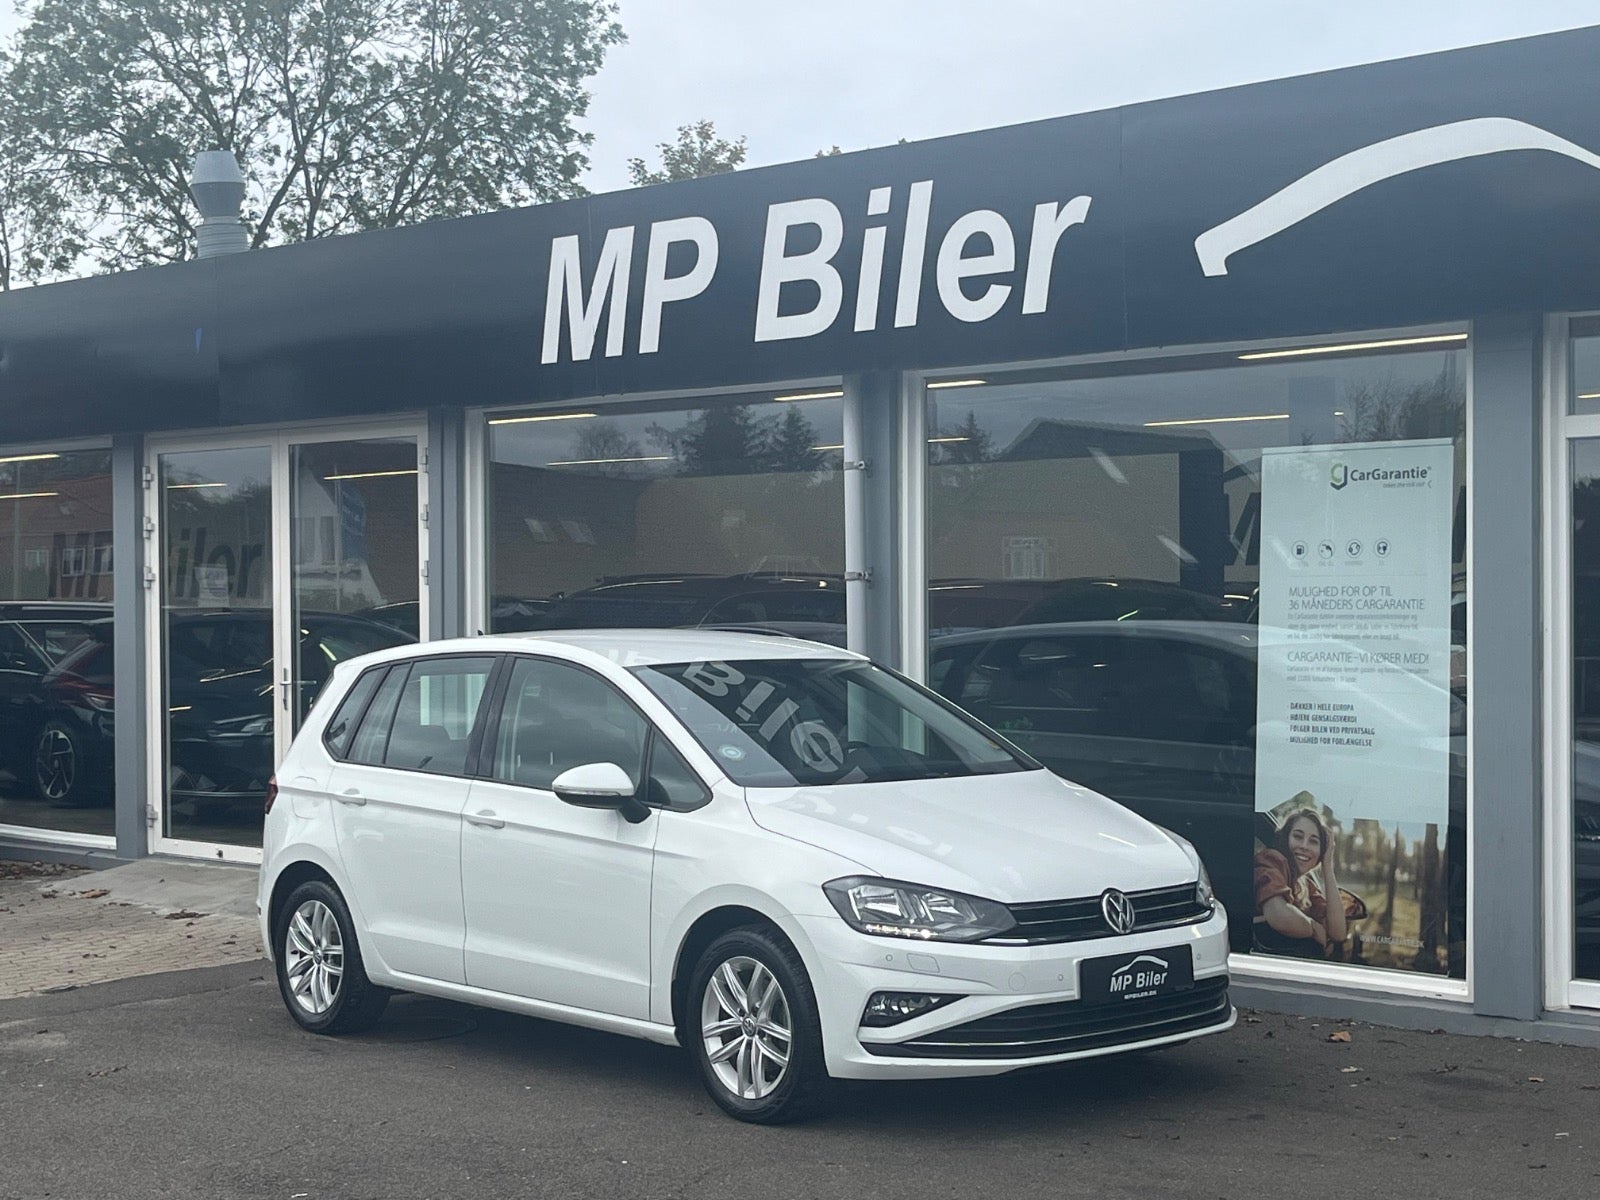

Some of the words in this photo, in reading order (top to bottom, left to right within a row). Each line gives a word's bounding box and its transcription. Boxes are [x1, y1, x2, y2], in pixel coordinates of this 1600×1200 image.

[541, 216, 719, 364] MP
[754, 179, 1092, 342] Biler
[1350, 466, 1428, 481] CarGarantie
[1288, 586, 1339, 598] MULIGHED
[1341, 586, 1361, 598] FOR
[1362, 586, 1377, 598] OP
[1380, 586, 1393, 597] TIL
[1288, 600, 1299, 610] 36
[1301, 598, 1354, 611] MÅNEDERS
[1356, 599, 1425, 610] CARGARANTIE
[1287, 652, 1352, 664] CARGARANTIE
[1332, 703, 1354, 711] EUROPA
[1341, 727, 1375, 736] PRIVATSALG
[1109, 975, 1133, 992] MP
[1135, 971, 1168, 989] Biler
